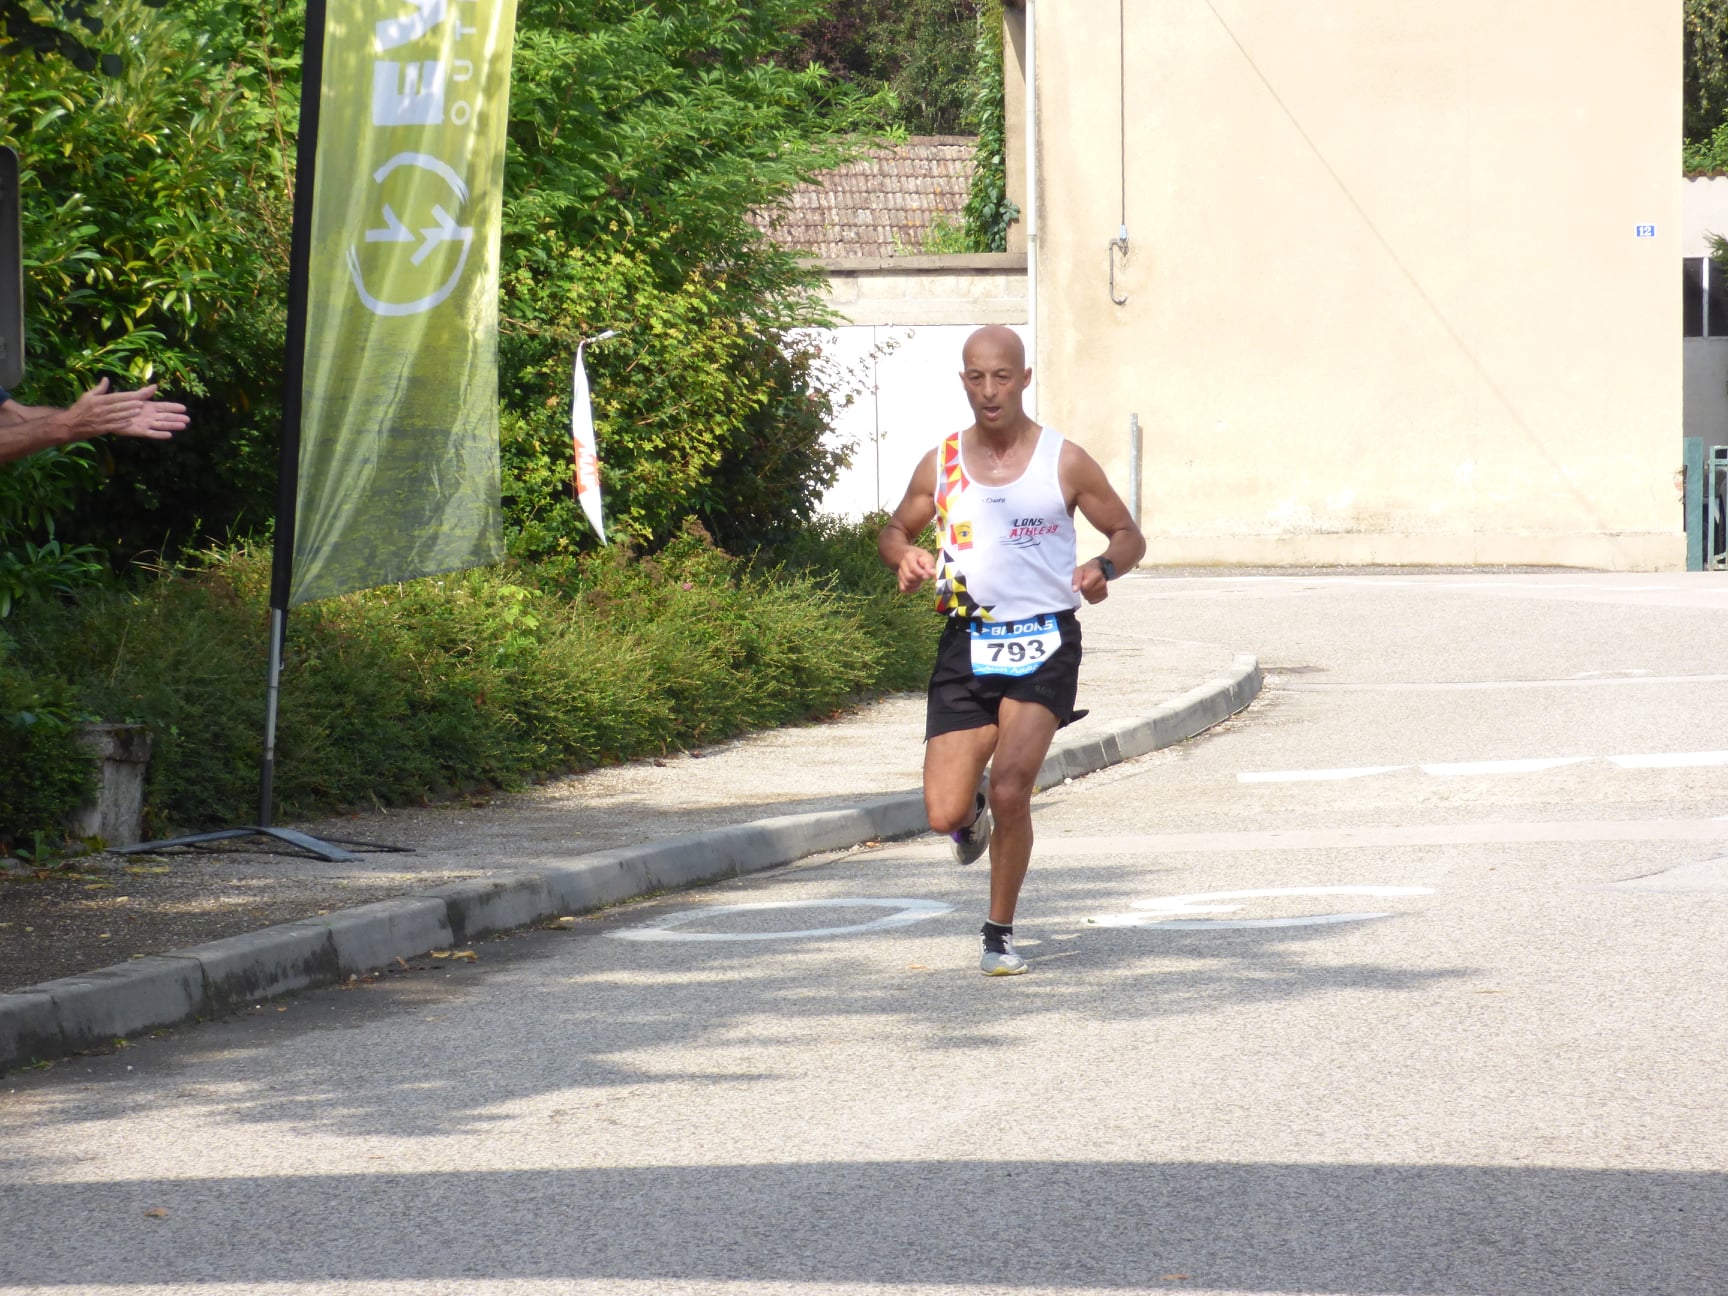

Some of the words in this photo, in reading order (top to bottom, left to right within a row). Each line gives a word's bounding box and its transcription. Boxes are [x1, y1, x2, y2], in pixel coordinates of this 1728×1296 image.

[451, 0, 478, 126] OUT
[1640, 226, 1651, 236] 12
[1014, 518, 1044, 528] LONS
[987, 640, 1047, 662] 793
